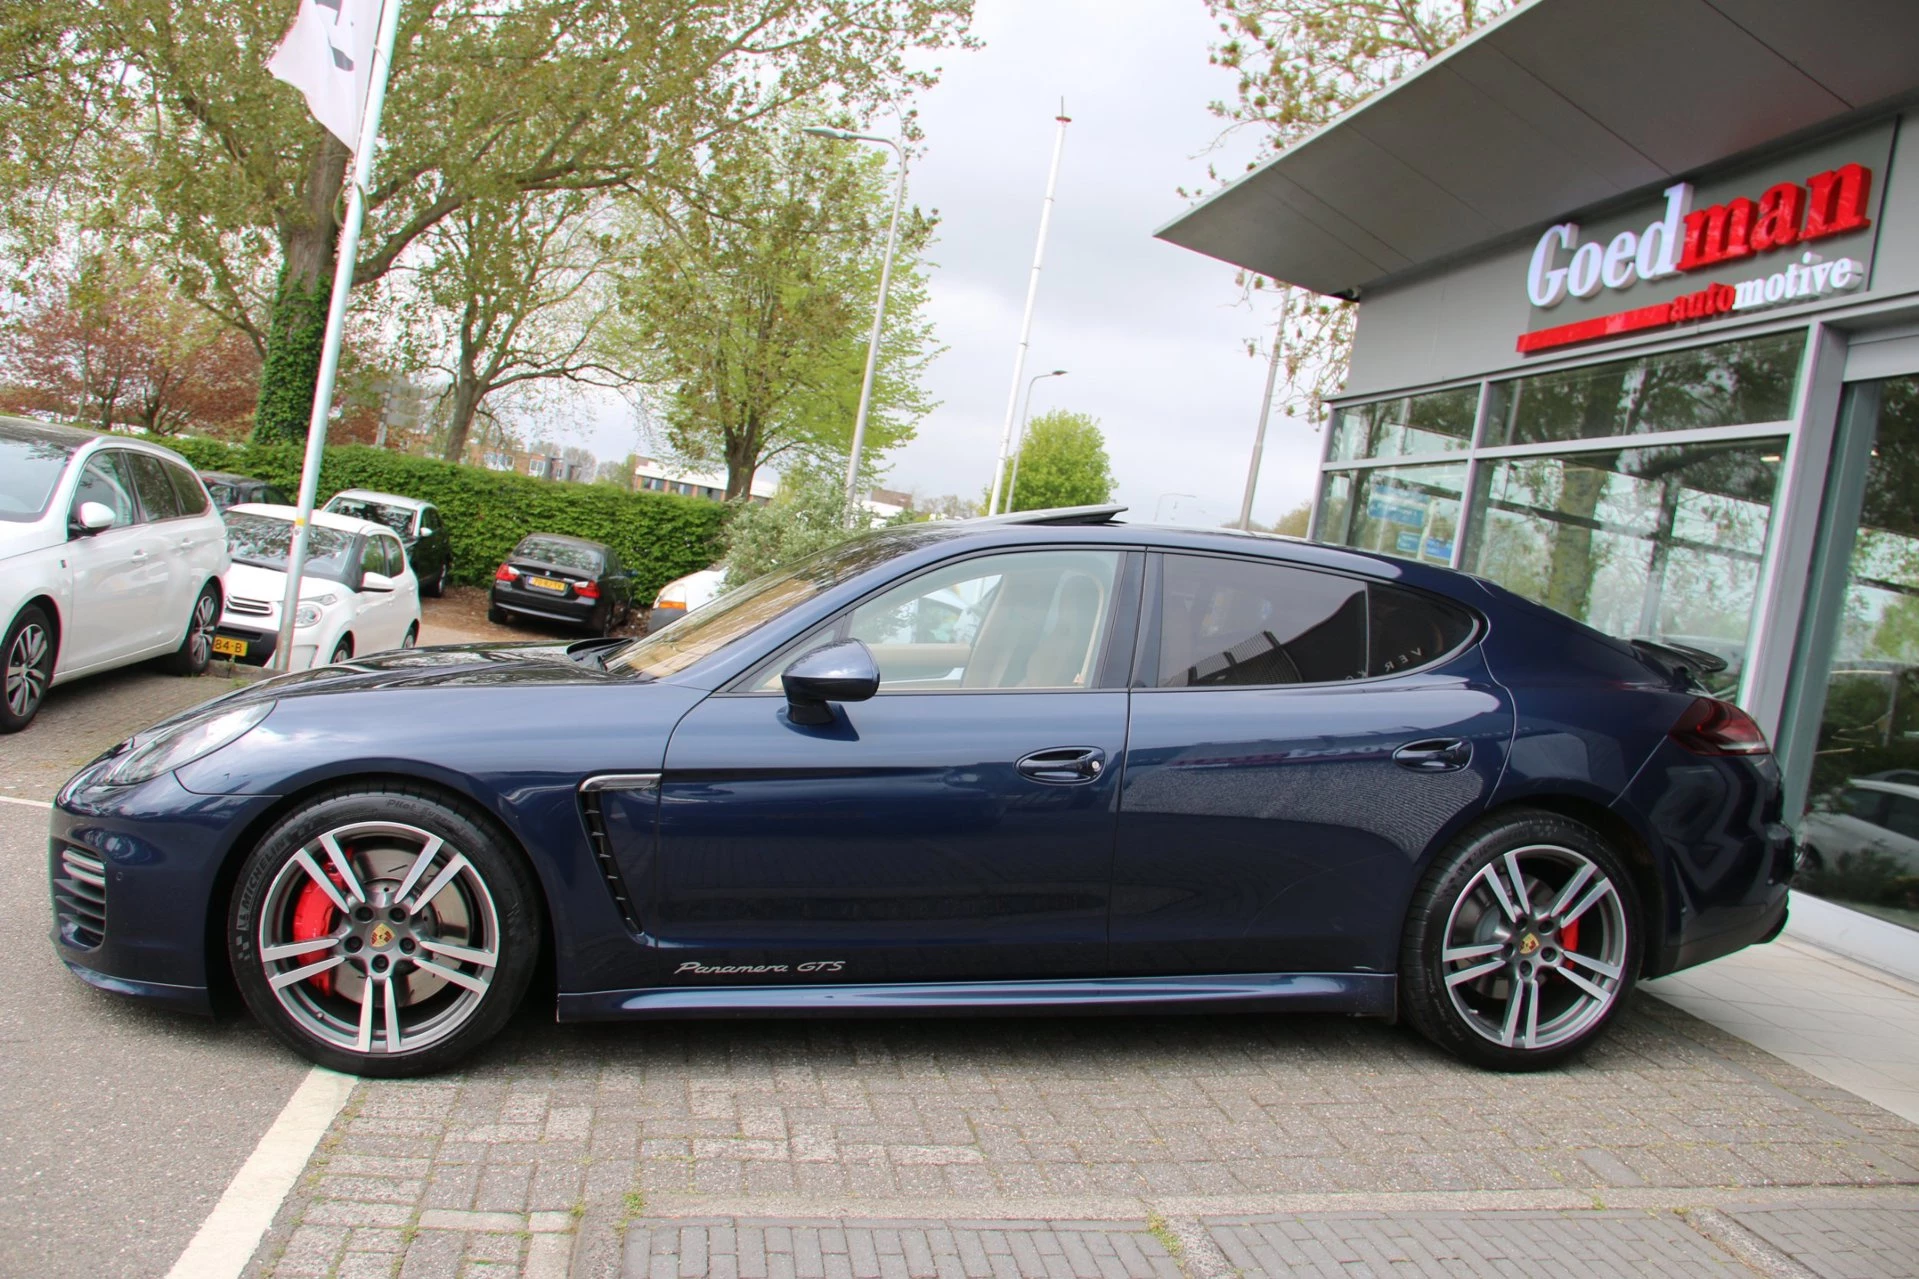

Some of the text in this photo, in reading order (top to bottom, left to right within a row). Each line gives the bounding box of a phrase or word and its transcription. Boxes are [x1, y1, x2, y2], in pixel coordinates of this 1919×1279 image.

[1527, 163, 1872, 308] Goedman
[1670, 251, 1863, 322] automotive
[674, 960, 847, 975] Panamera GTS
